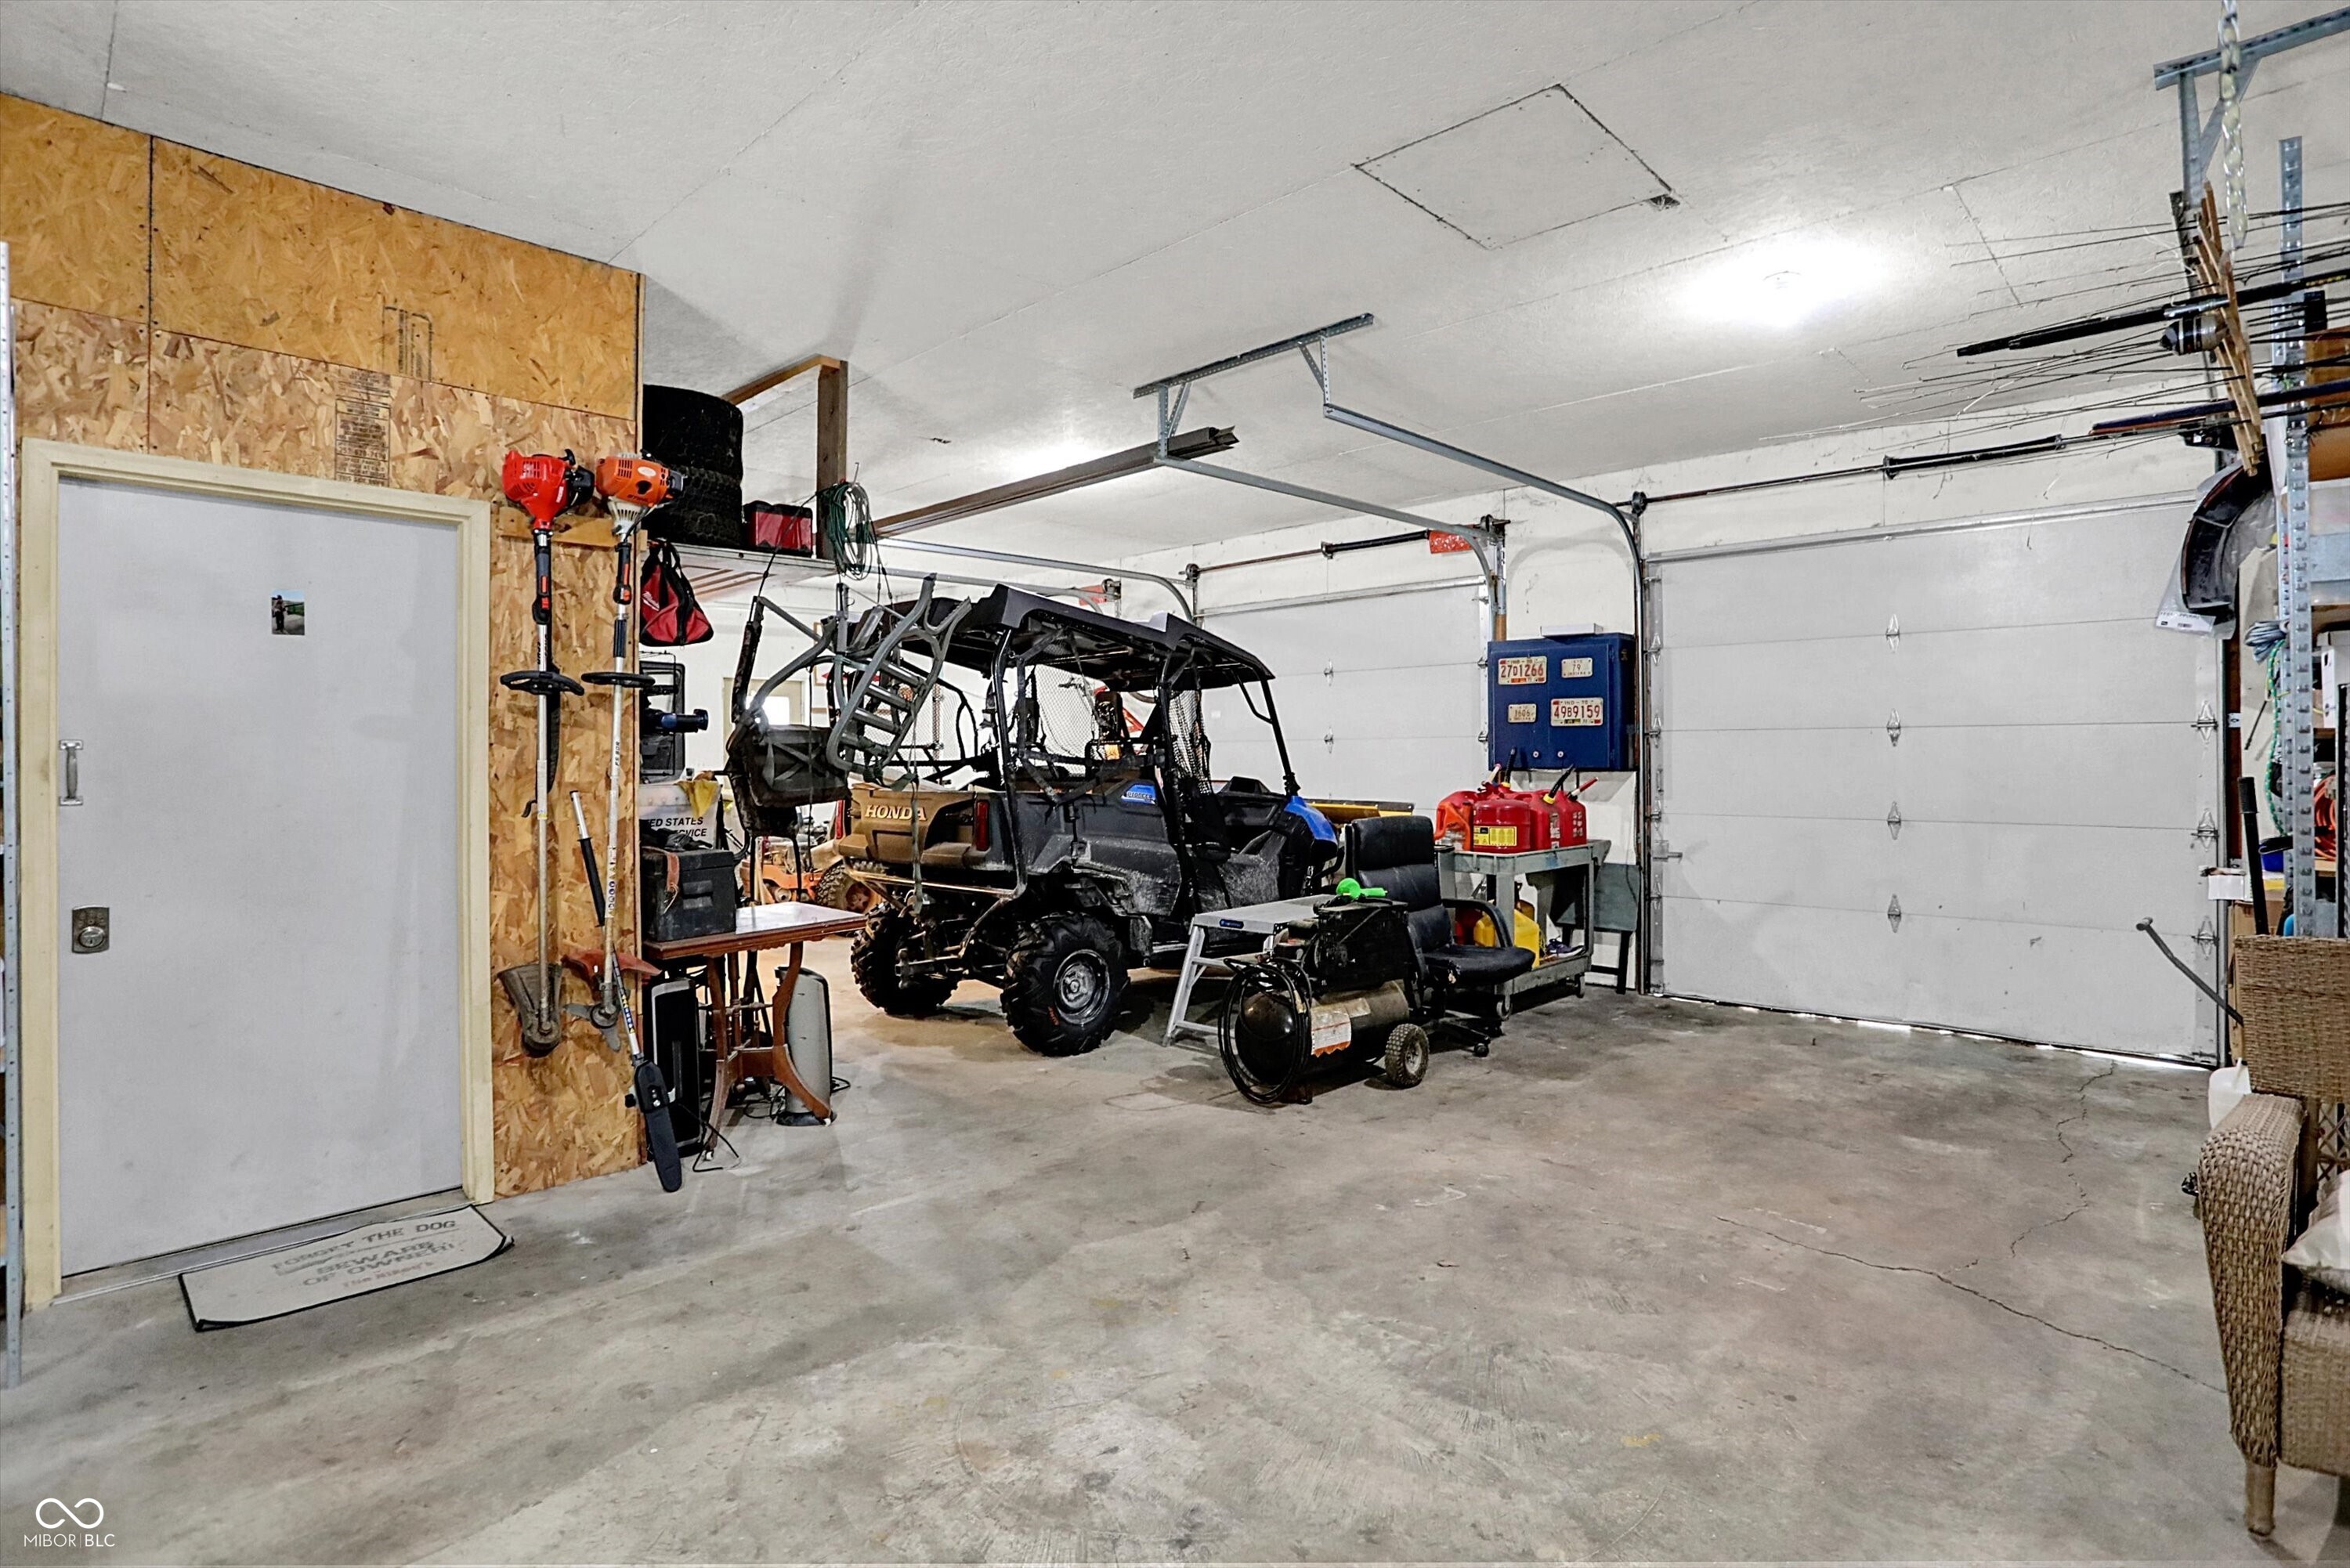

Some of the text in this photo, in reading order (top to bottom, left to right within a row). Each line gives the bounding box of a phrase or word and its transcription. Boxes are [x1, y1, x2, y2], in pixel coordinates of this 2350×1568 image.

[1553, 704, 1601, 718] 49B9159
[864, 804, 927, 821] HONDA
[665, 816, 704, 827] STATES
[362, 1227, 404, 1244] THE
[415, 1220, 456, 1234] DOG
